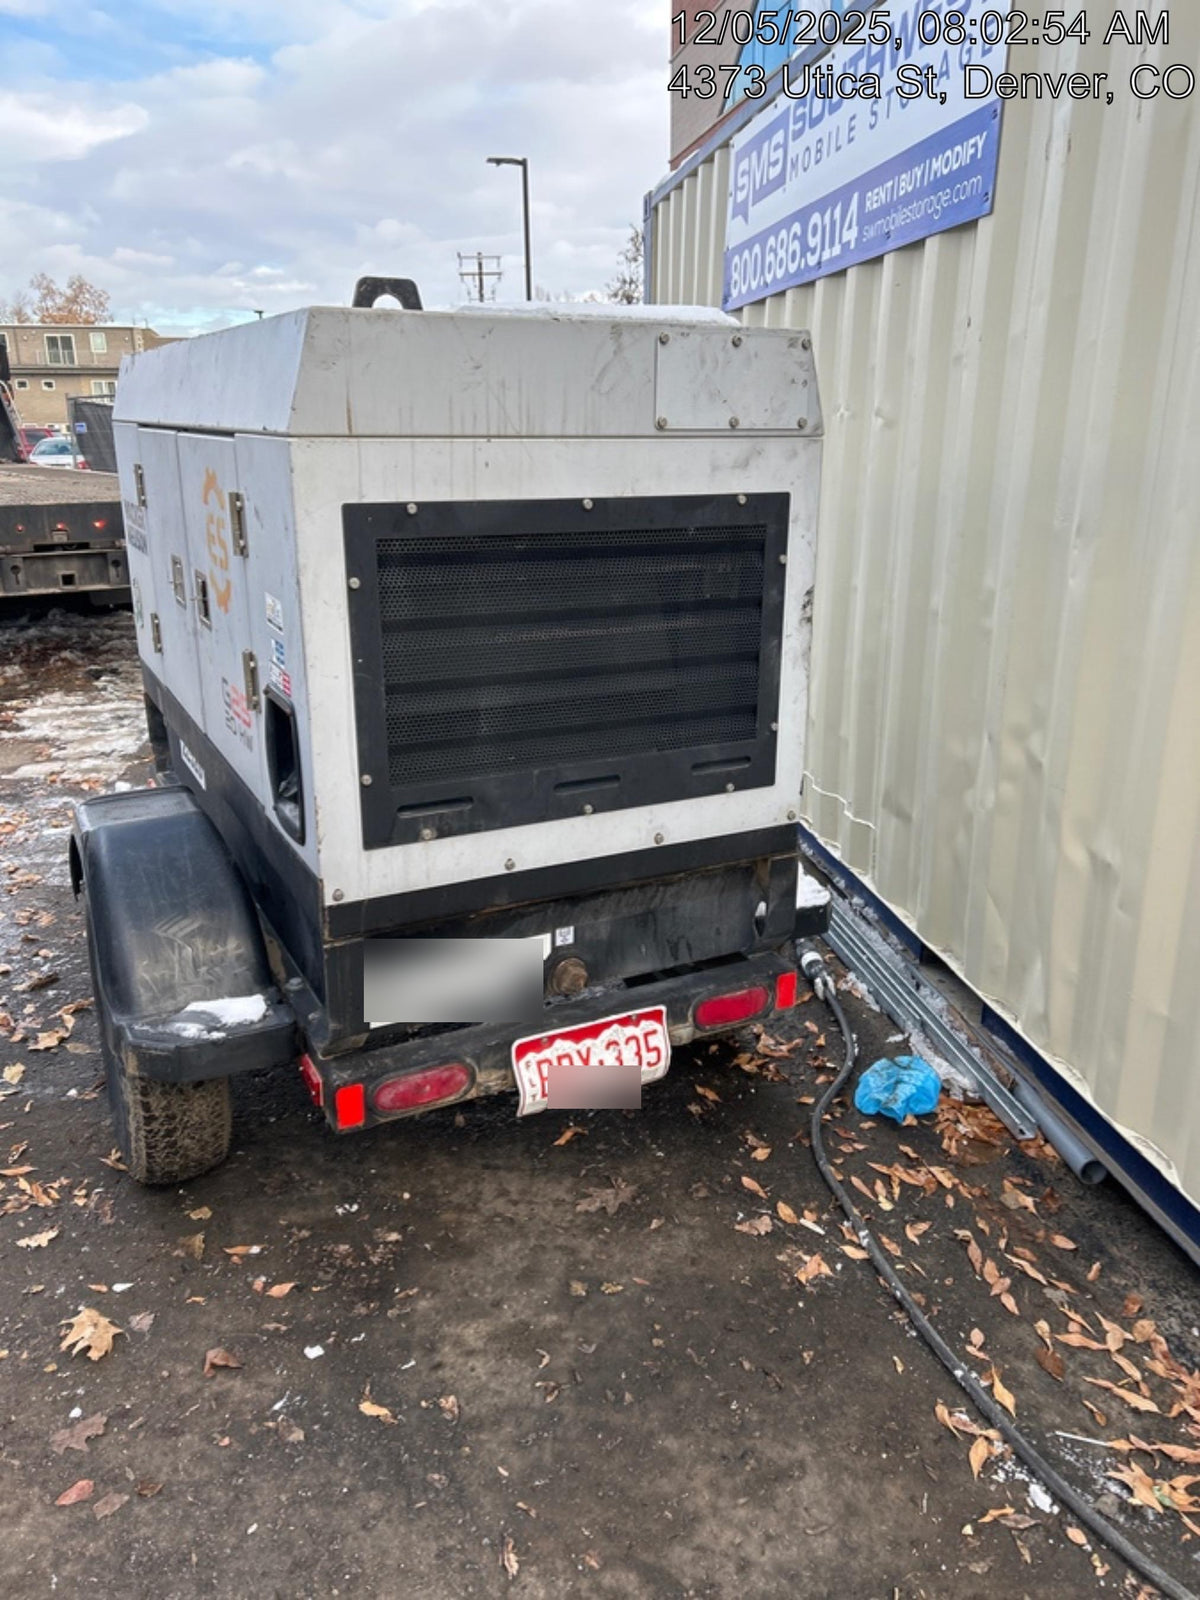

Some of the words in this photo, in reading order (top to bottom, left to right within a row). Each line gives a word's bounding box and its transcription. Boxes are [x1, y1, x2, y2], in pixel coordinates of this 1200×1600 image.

[791, 0, 989, 142] SOUTHWE
[736, 128, 786, 204] SMS
[789, 113, 857, 182] MOBILE
[929, 130, 987, 181] MODIFY
[862, 174, 984, 243] swmobilestorage.com
[729, 191, 860, 299] 800.686.9114
